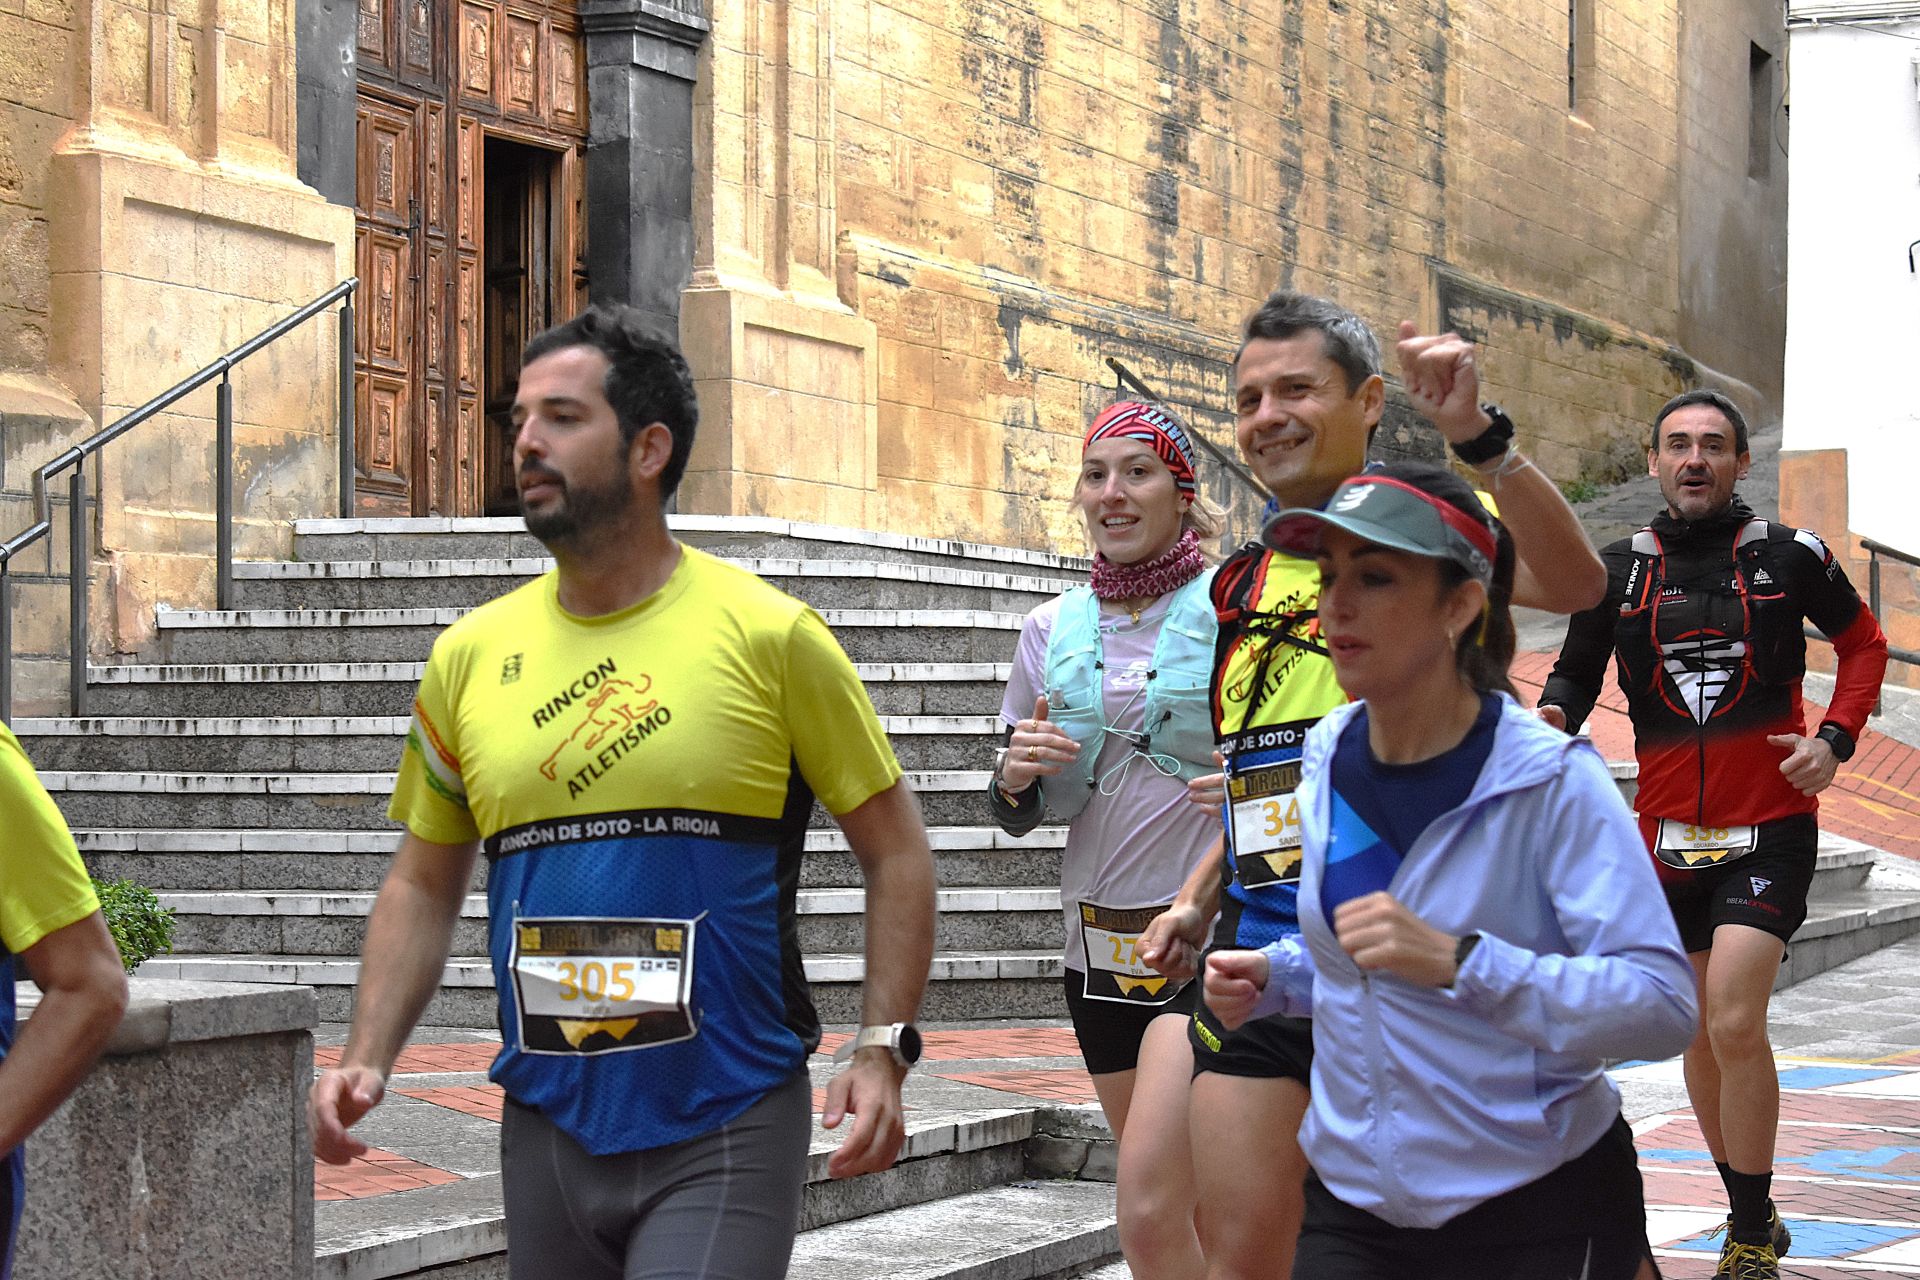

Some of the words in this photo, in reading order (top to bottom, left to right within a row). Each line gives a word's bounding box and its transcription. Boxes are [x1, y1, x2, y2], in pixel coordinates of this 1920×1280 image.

[532, 656, 617, 730] RINCON
[566, 706, 672, 801] ATLETISMO
[1258, 729, 1295, 748] SOTO
[1247, 767, 1299, 793] TRAIL
[558, 822, 582, 841] DE
[585, 818, 631, 838] SOTO
[643, 816, 667, 833] LA
[672, 816, 721, 836] RIOJA
[1262, 797, 1301, 837] 34
[1278, 834, 1301, 846] SANT
[557, 961, 636, 1002] 305
